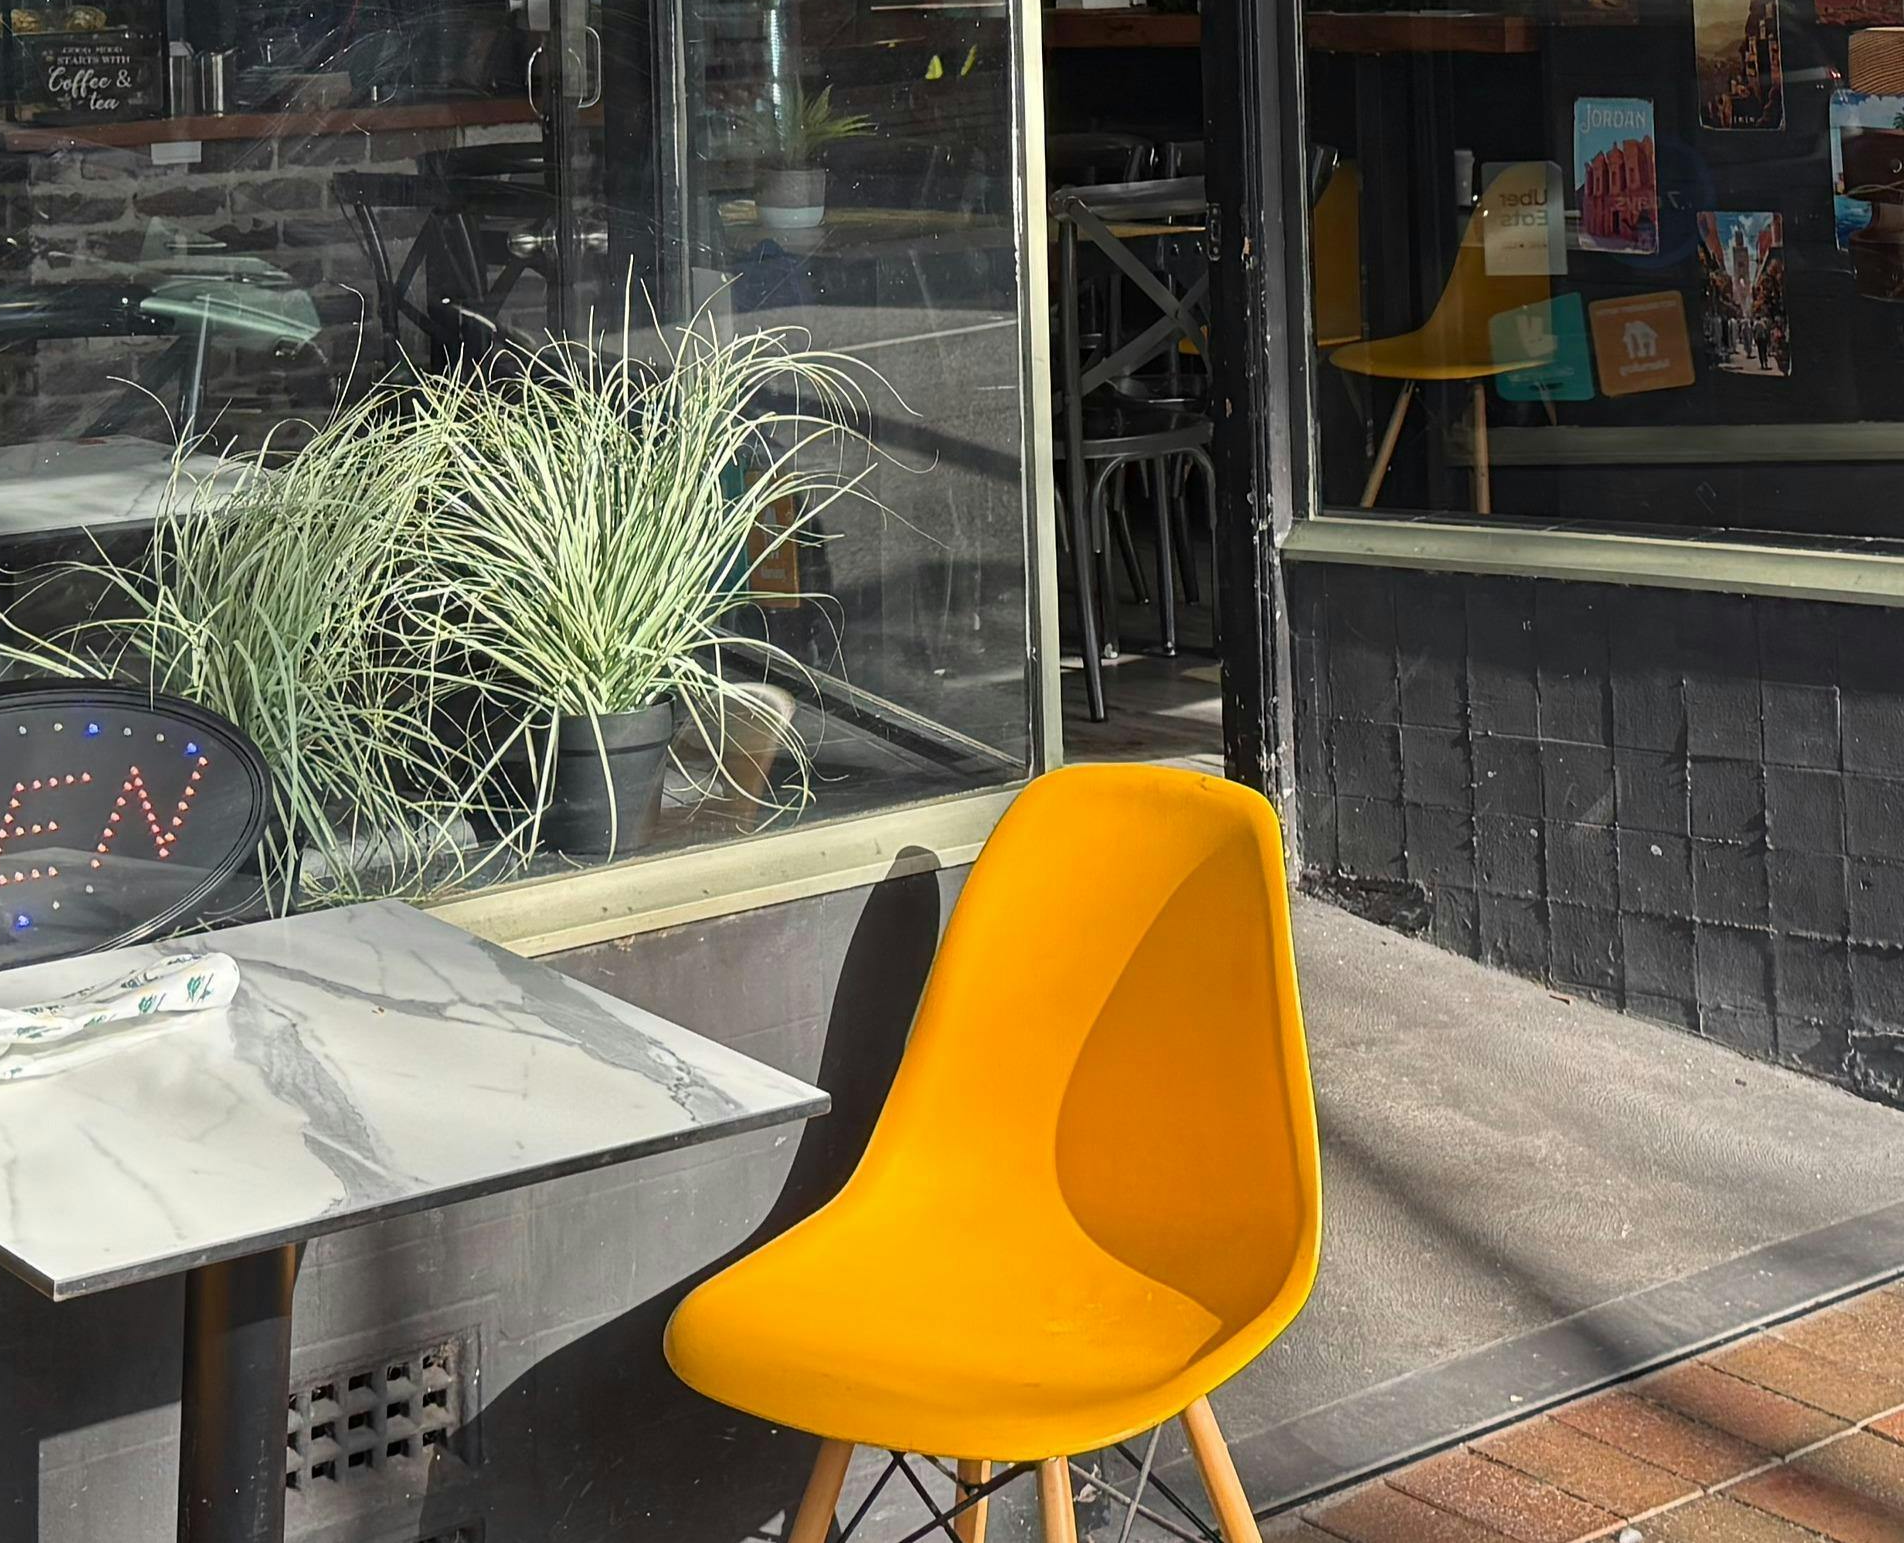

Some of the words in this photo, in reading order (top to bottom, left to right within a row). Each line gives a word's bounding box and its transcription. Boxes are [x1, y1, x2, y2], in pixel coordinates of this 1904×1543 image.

[57, 55, 99, 65] STARTS
[101, 54, 131, 65] WITH
[48, 66, 112, 99] Coffee
[116, 68, 132, 88] &
[89, 91, 120, 111] tea
[1580, 103, 1646, 132] JORDAN
